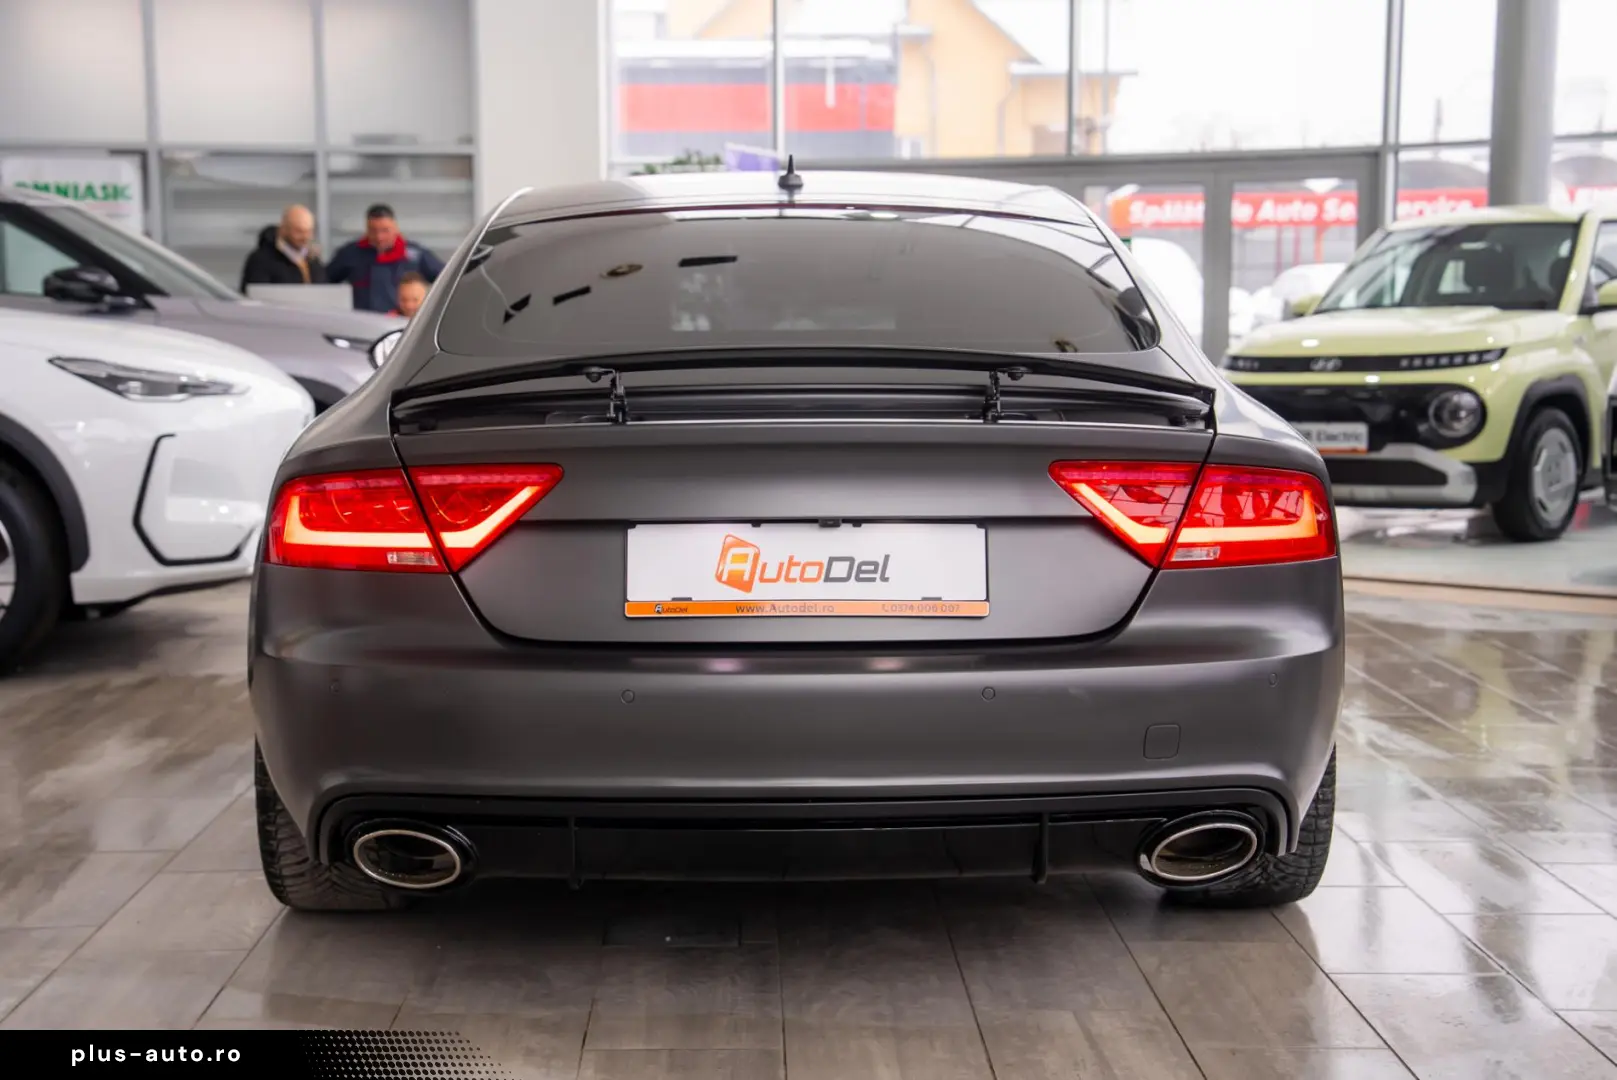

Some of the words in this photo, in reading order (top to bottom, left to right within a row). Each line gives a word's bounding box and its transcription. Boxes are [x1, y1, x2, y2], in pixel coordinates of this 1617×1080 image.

[1255, 198, 1318, 222] Auto
[716, 534, 890, 593] AutoDel
[654, 603, 689, 614] AutoDel
[735, 603, 835, 614] www.Autodel.ro
